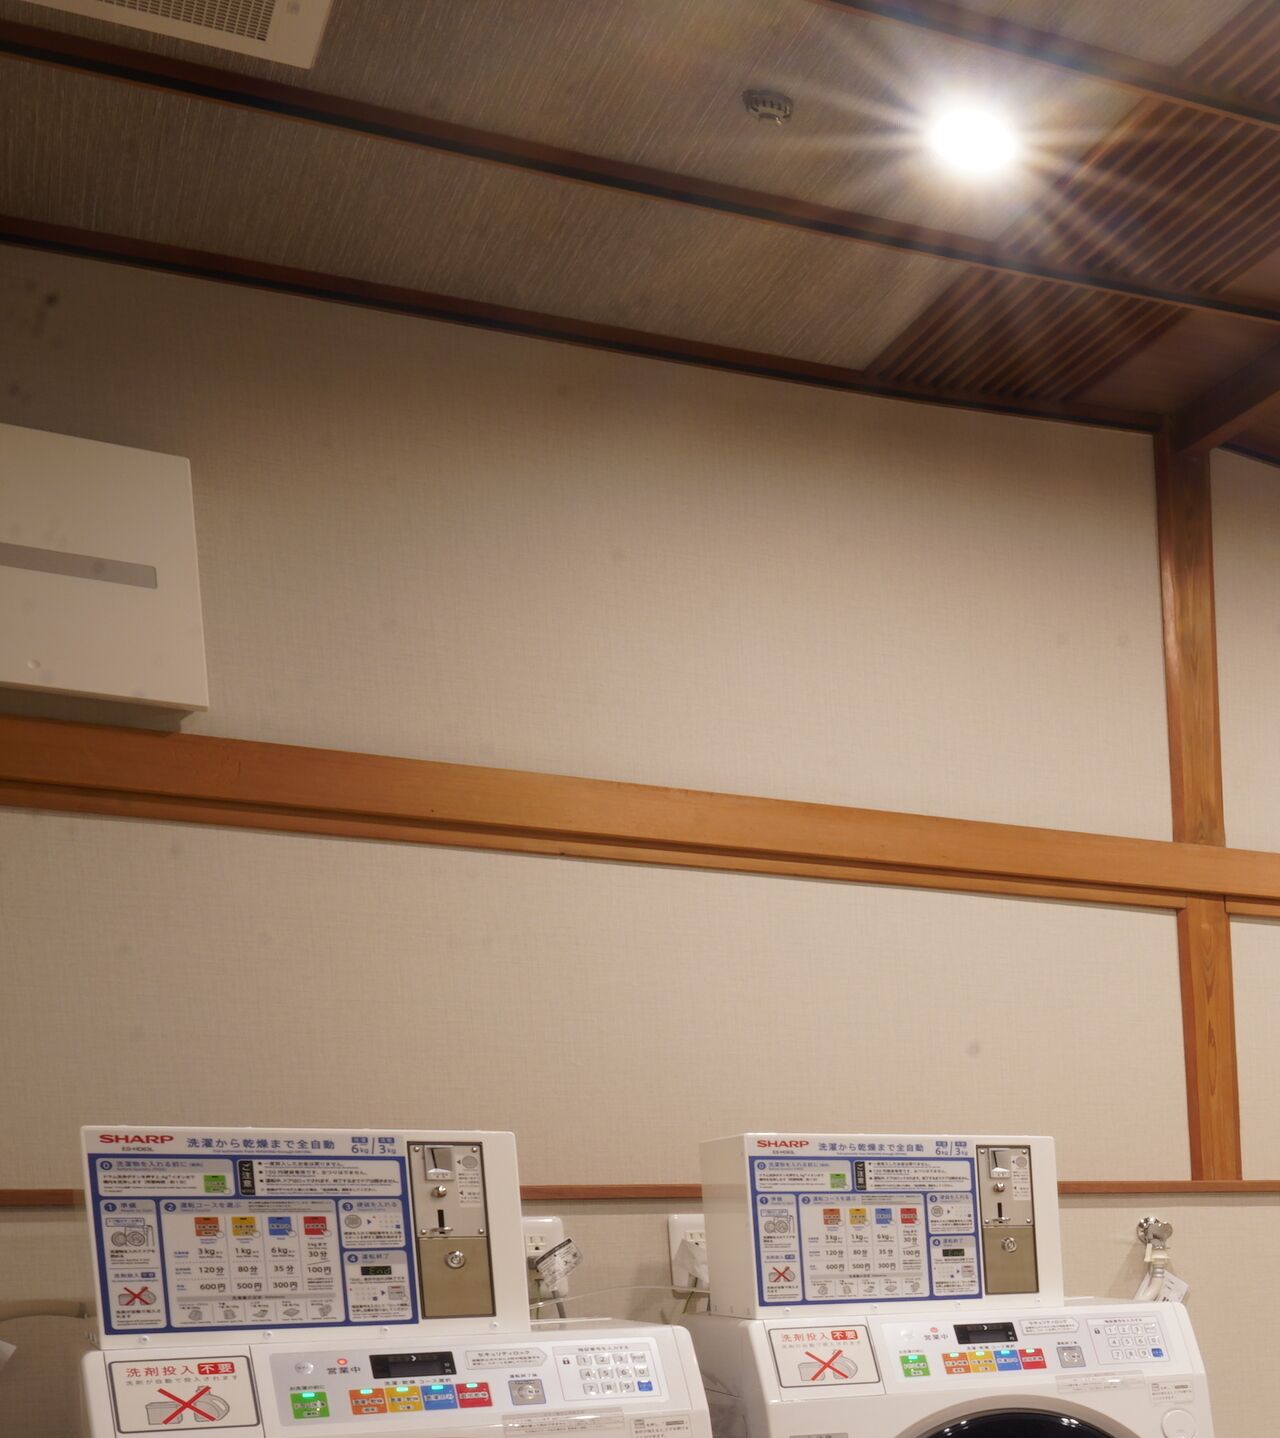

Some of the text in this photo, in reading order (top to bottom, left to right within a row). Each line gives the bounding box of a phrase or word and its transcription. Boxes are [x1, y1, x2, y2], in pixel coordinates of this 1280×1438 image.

[99, 1134, 174, 1144] SHARP
[186, 1137, 336, 1151] 洗濯から乾燥まで全自動
[756, 1140, 810, 1148] SHARP
[818, 1142, 924, 1152] 洗濯から乾燥まで全自動
[781, 1332, 831, 1343] 洗剤投入
[126, 1362, 233, 1378] 洗剤投入 不要
[327, 1366, 360, 1375] 営業中
[126, 1374, 239, 1387] 洗剤が自動で投入されます
